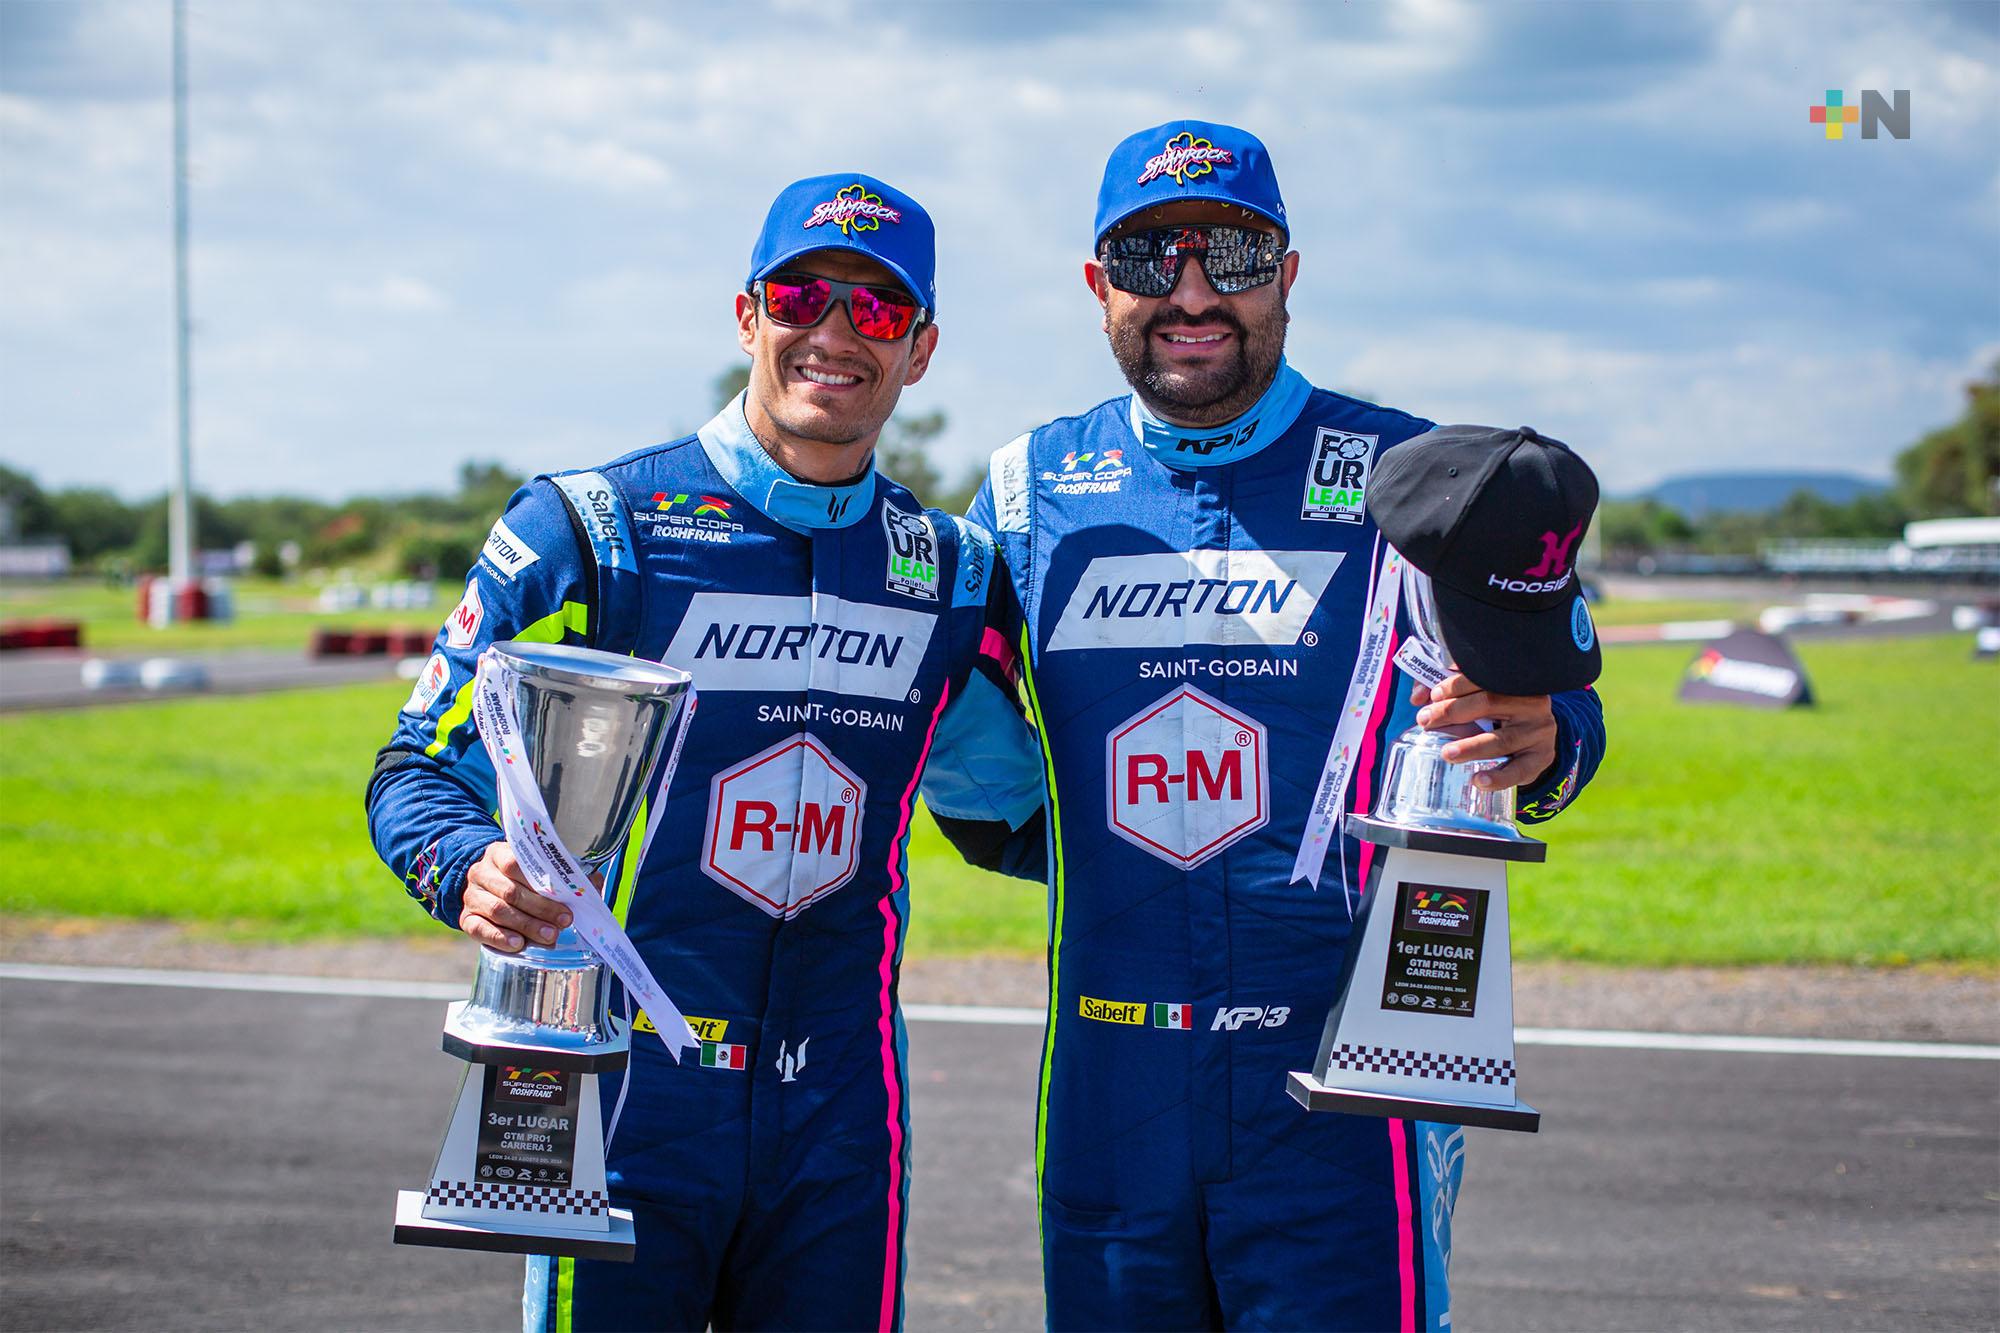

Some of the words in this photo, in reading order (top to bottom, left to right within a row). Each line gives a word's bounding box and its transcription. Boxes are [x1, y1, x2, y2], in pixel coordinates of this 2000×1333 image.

[1140, 147, 1231, 181] SHAMROCK
[806, 198, 900, 226] SHAMROCK
[1094, 467, 1132, 481] COPA
[1308, 486, 1364, 506] LEAF
[1319, 505, 1348, 513] Pallets
[587, 489, 627, 554] Sabelt
[696, 518, 744, 532] COPA
[891, 555, 937, 583] LEAF
[1082, 579, 1297, 620] NORTON
[694, 622, 904, 668] NORTON
[1139, 659, 1298, 678] SAINT-GOBAIN
[757, 703, 904, 731] SAINT-GOBAIN
[1127, 749, 1243, 805] R-M
[729, 800, 847, 856] R-M
[1418, 916, 1460, 928] ROSHFRANS
[1445, 912, 1469, 921] COPA
[1396, 941, 1421, 955] 1er
[1424, 944, 1474, 960] LUGAR
[1410, 958, 1431, 968] GTM
[1406, 968, 1450, 979] CARRERA
[1452, 972, 1459, 980] 2
[1084, 999, 1137, 1023] Sabelt
[510, 1087, 553, 1099] ROSHFRANS
[536, 1083, 562, 1091] COPA
[487, 1112, 514, 1126] 3er
[517, 1115, 569, 1131] LUGAR
[504, 1132, 526, 1141] GTM
[500, 1141, 545, 1151] CARRERA
[546, 1144, 553, 1152] 2
